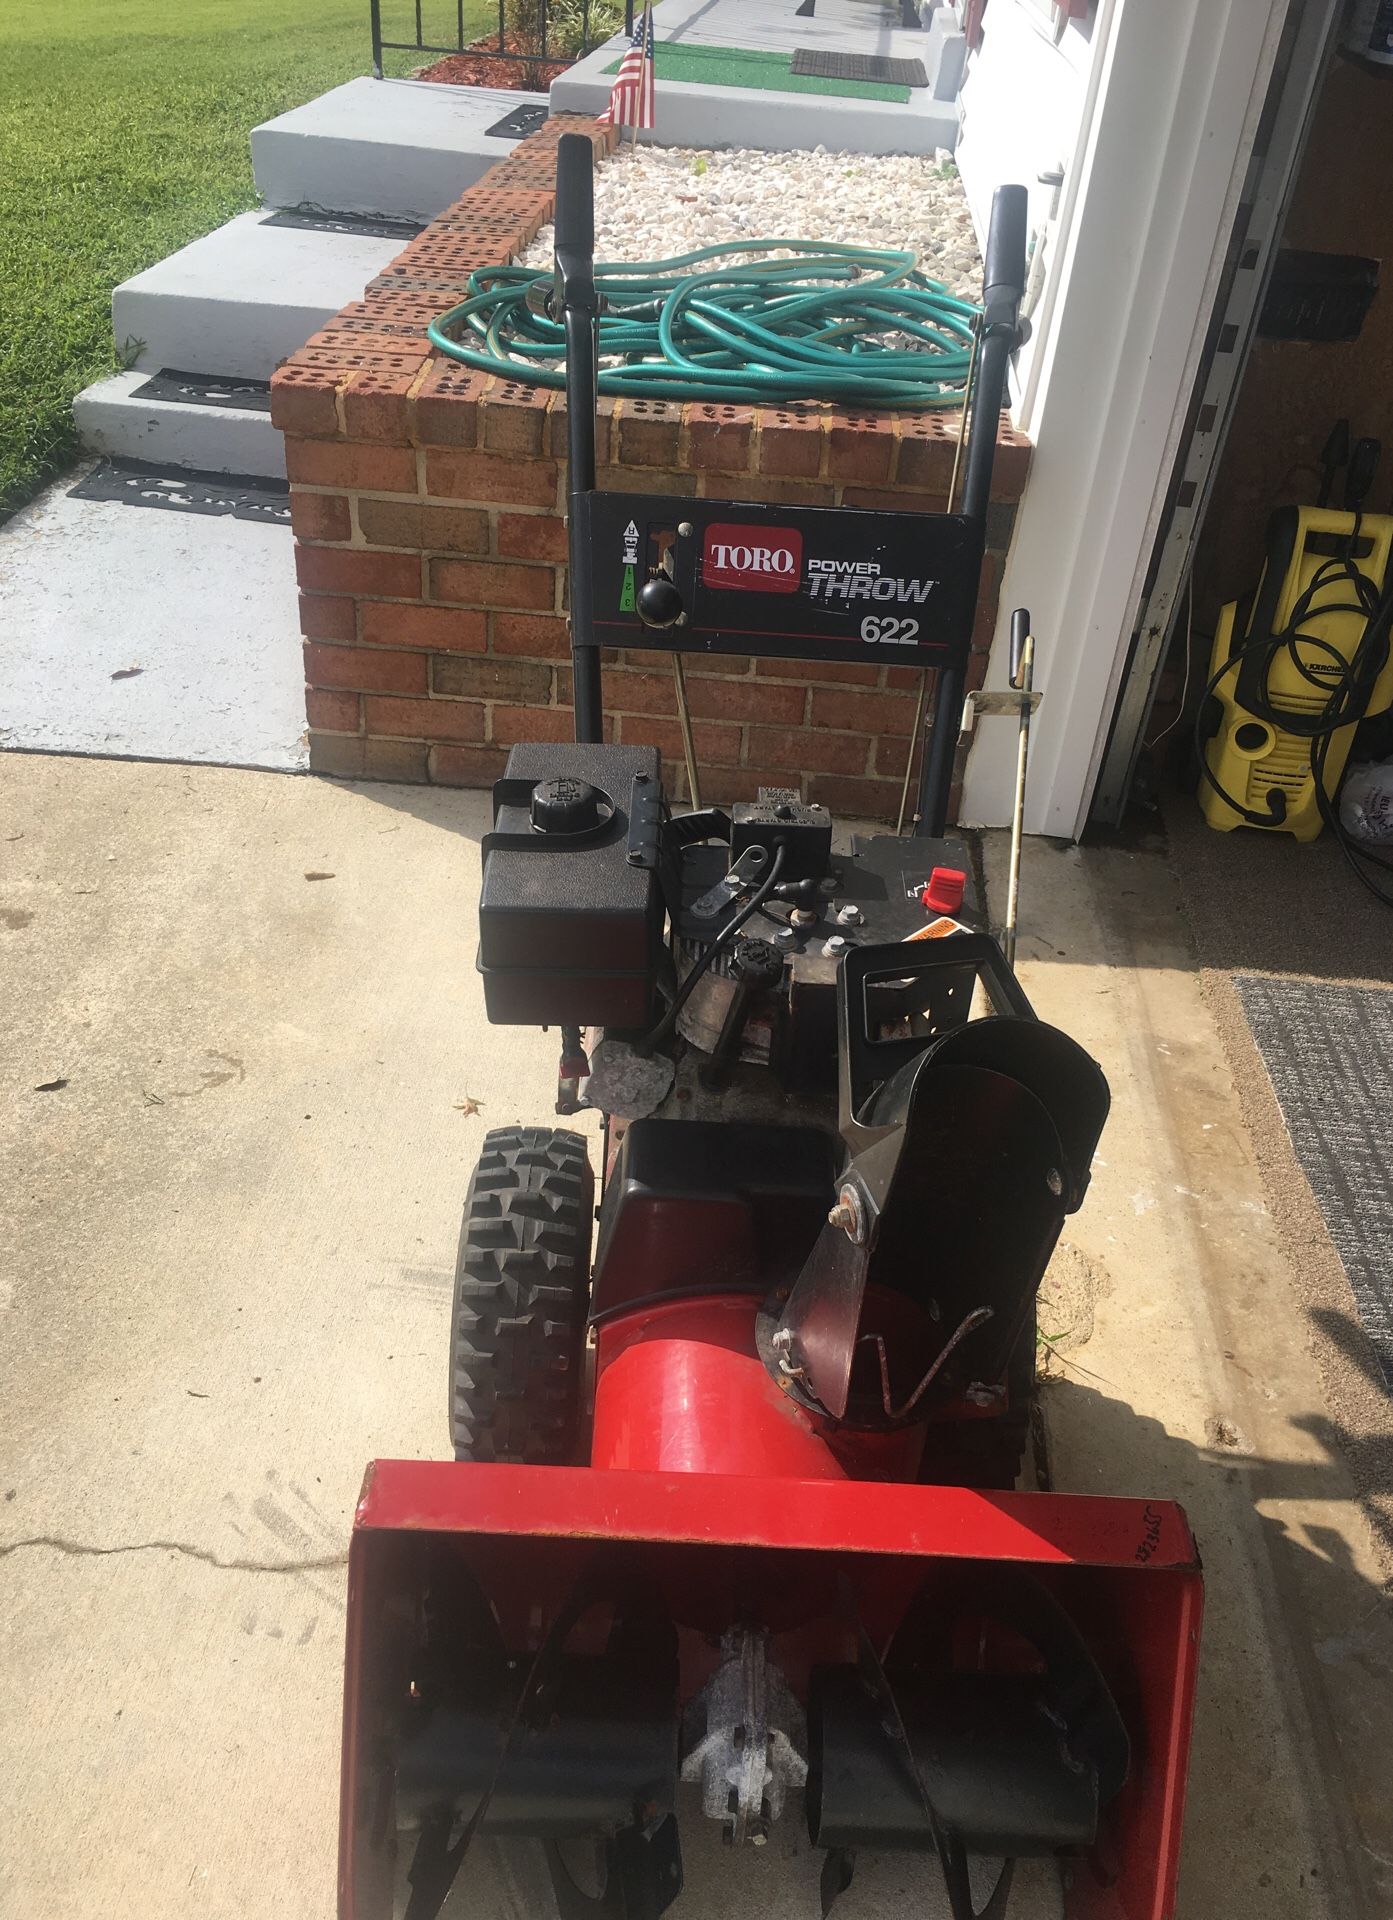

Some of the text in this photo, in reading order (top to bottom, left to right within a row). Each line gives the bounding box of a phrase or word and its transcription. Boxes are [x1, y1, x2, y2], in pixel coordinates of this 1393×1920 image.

[711, 544, 793, 573] TORO
[808, 559, 880, 575] POWER
[808, 572, 934, 603] THROW
[860, 615, 920, 646] 622
